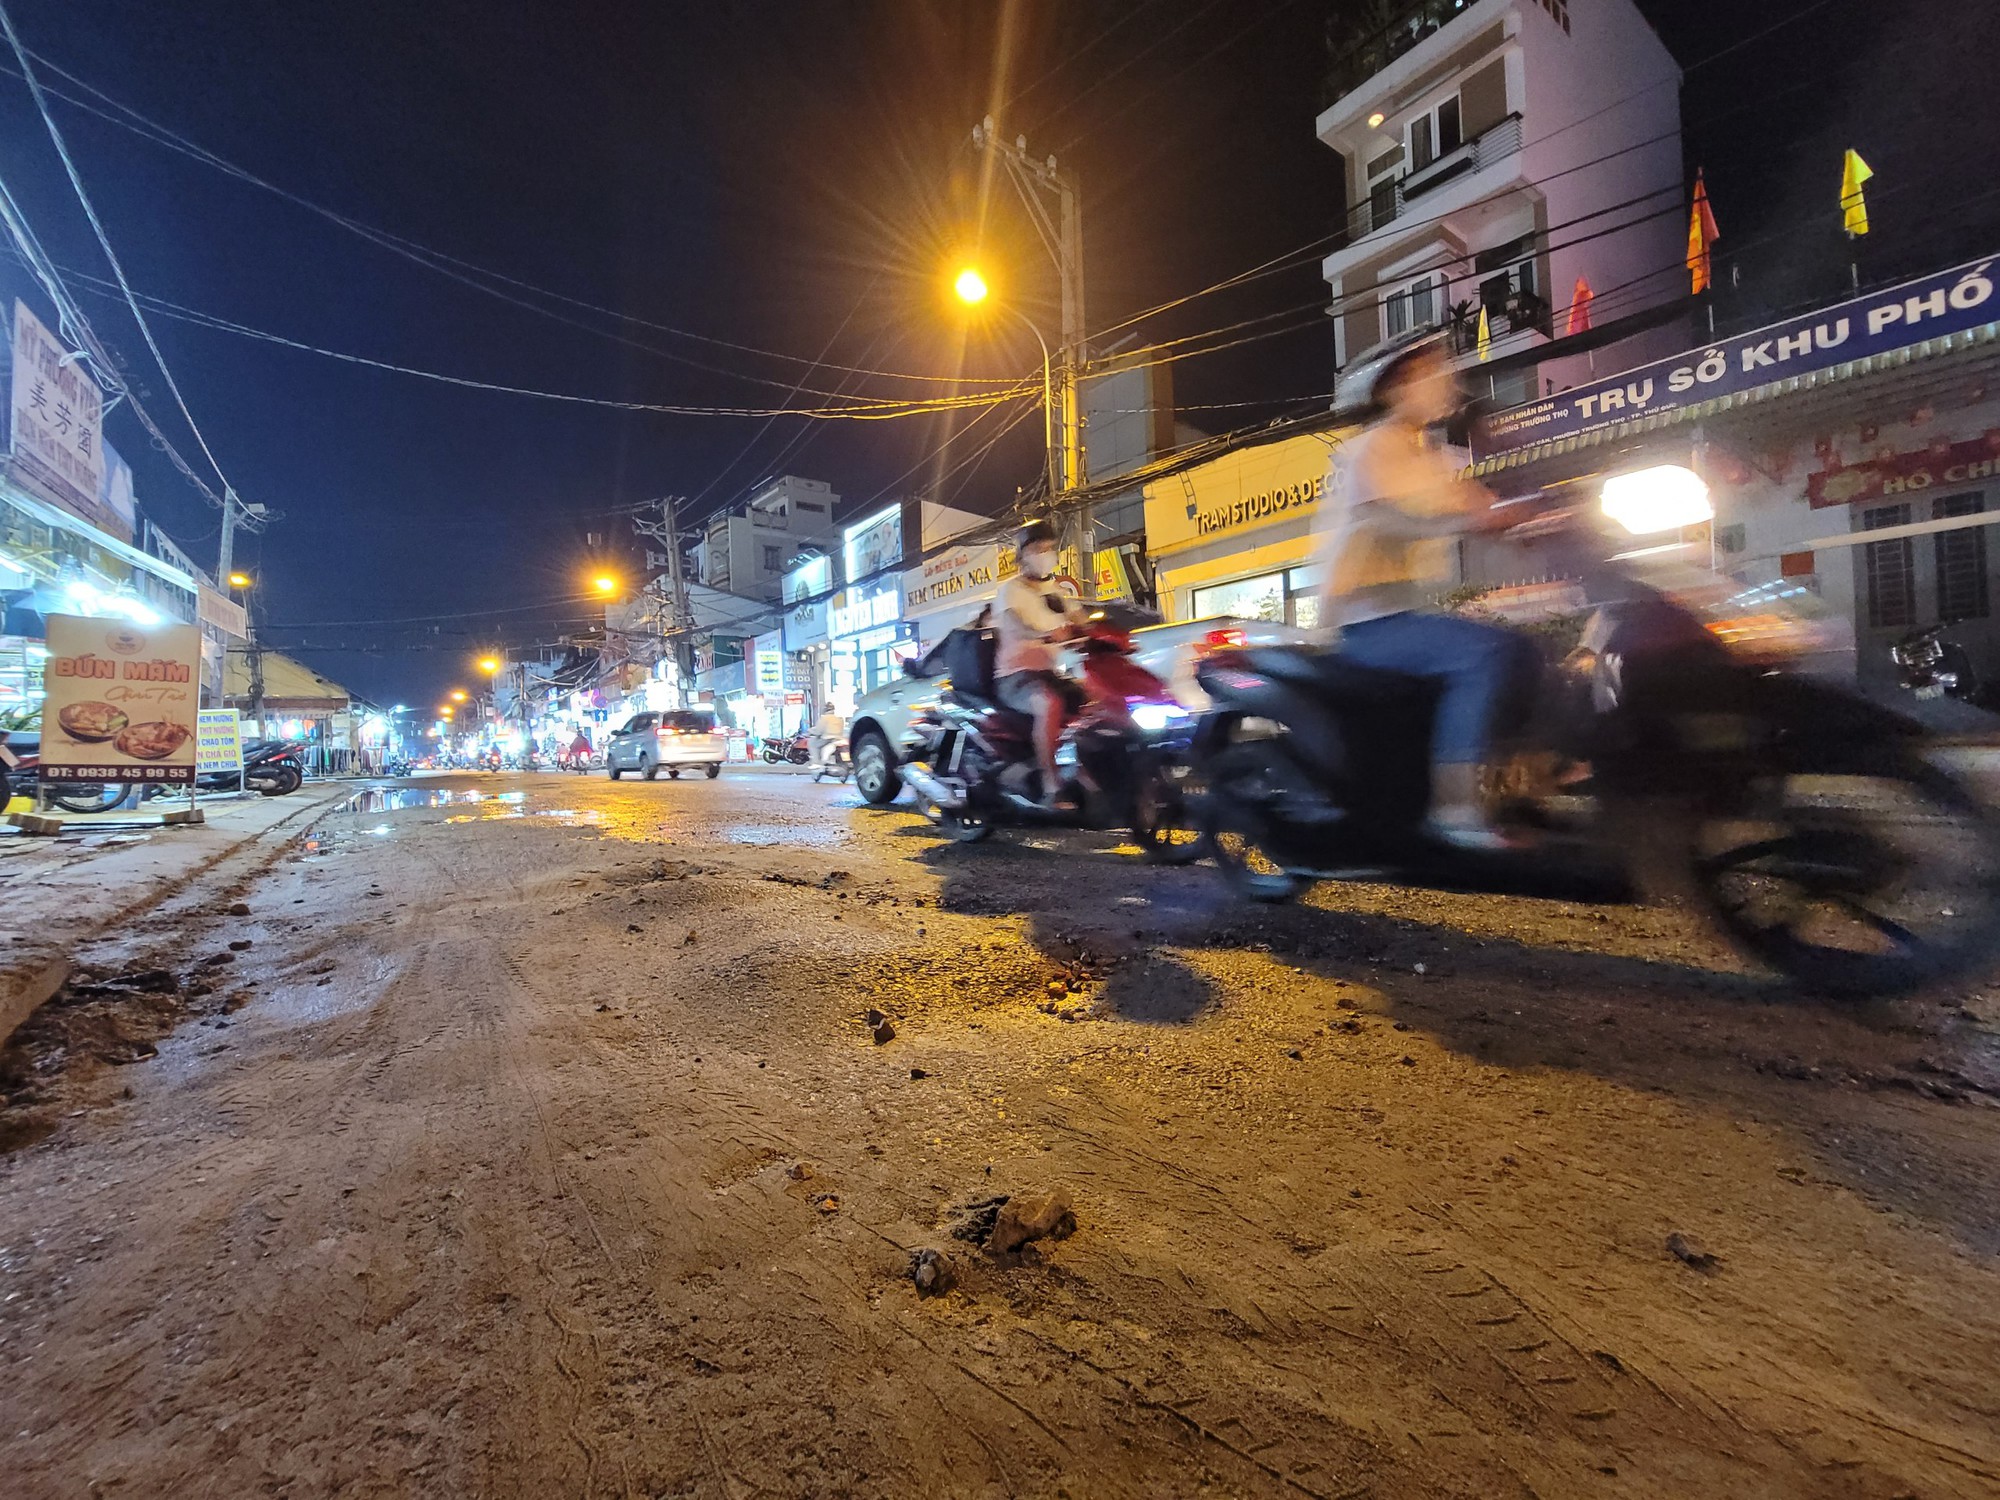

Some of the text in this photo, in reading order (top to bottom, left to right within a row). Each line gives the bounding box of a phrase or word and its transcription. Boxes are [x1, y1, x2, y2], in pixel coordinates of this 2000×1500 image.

[1574, 261, 1994, 418] TRỤ SỞ KHU PHỐ
[1520, 413, 1551, 429] TRƯỜNG
[1552, 408, 1569, 420] THỌ
[1538, 402, 1554, 414] DÂN
[1232, 488, 1286, 524] STUDIO
[1288, 484, 1302, 506] &
[908, 587, 928, 607] KIM
[968, 566, 992, 588] NGA
[56, 652, 190, 683] BÚN MẮM
[221, 736, 234, 746] TÔM
[48, 766, 188, 778] ĐT: 0938 45 99 55
[220, 760, 238, 768] CHUA
